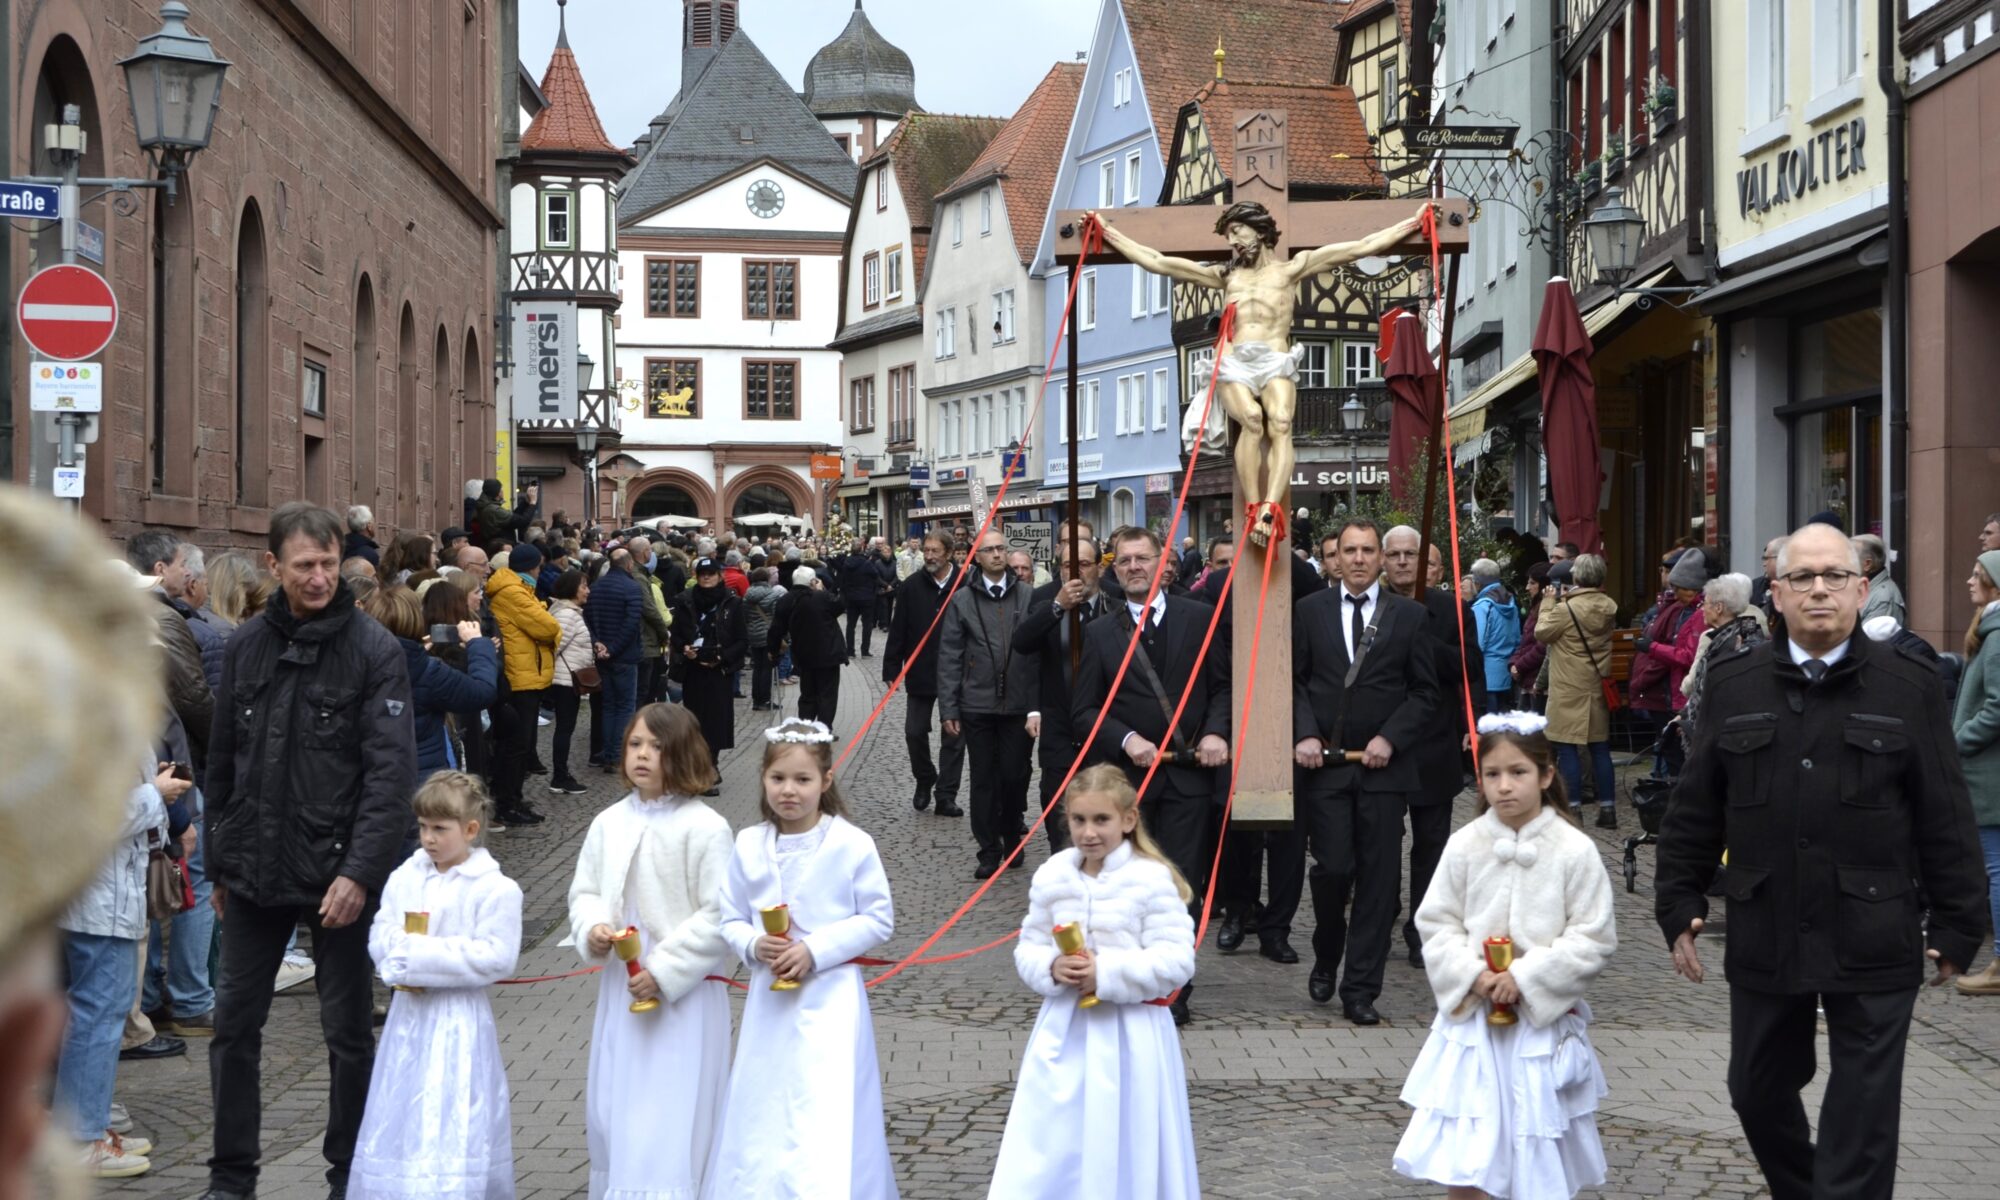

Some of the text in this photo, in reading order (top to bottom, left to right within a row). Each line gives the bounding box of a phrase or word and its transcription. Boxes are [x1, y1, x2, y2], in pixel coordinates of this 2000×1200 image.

[1246, 127, 1274, 143] IN
[1416, 128, 1505, 146] Café Rosenkranz
[1246, 155, 1275, 171] RI
[0, 190, 46, 211] raße
[526, 323, 538, 376] fahrschule
[527, 313, 560, 413] mersi
[972, 479, 984, 504] HASS
[917, 503, 972, 517] HUNGER
[1005, 524, 1051, 538] Das Kreuz
